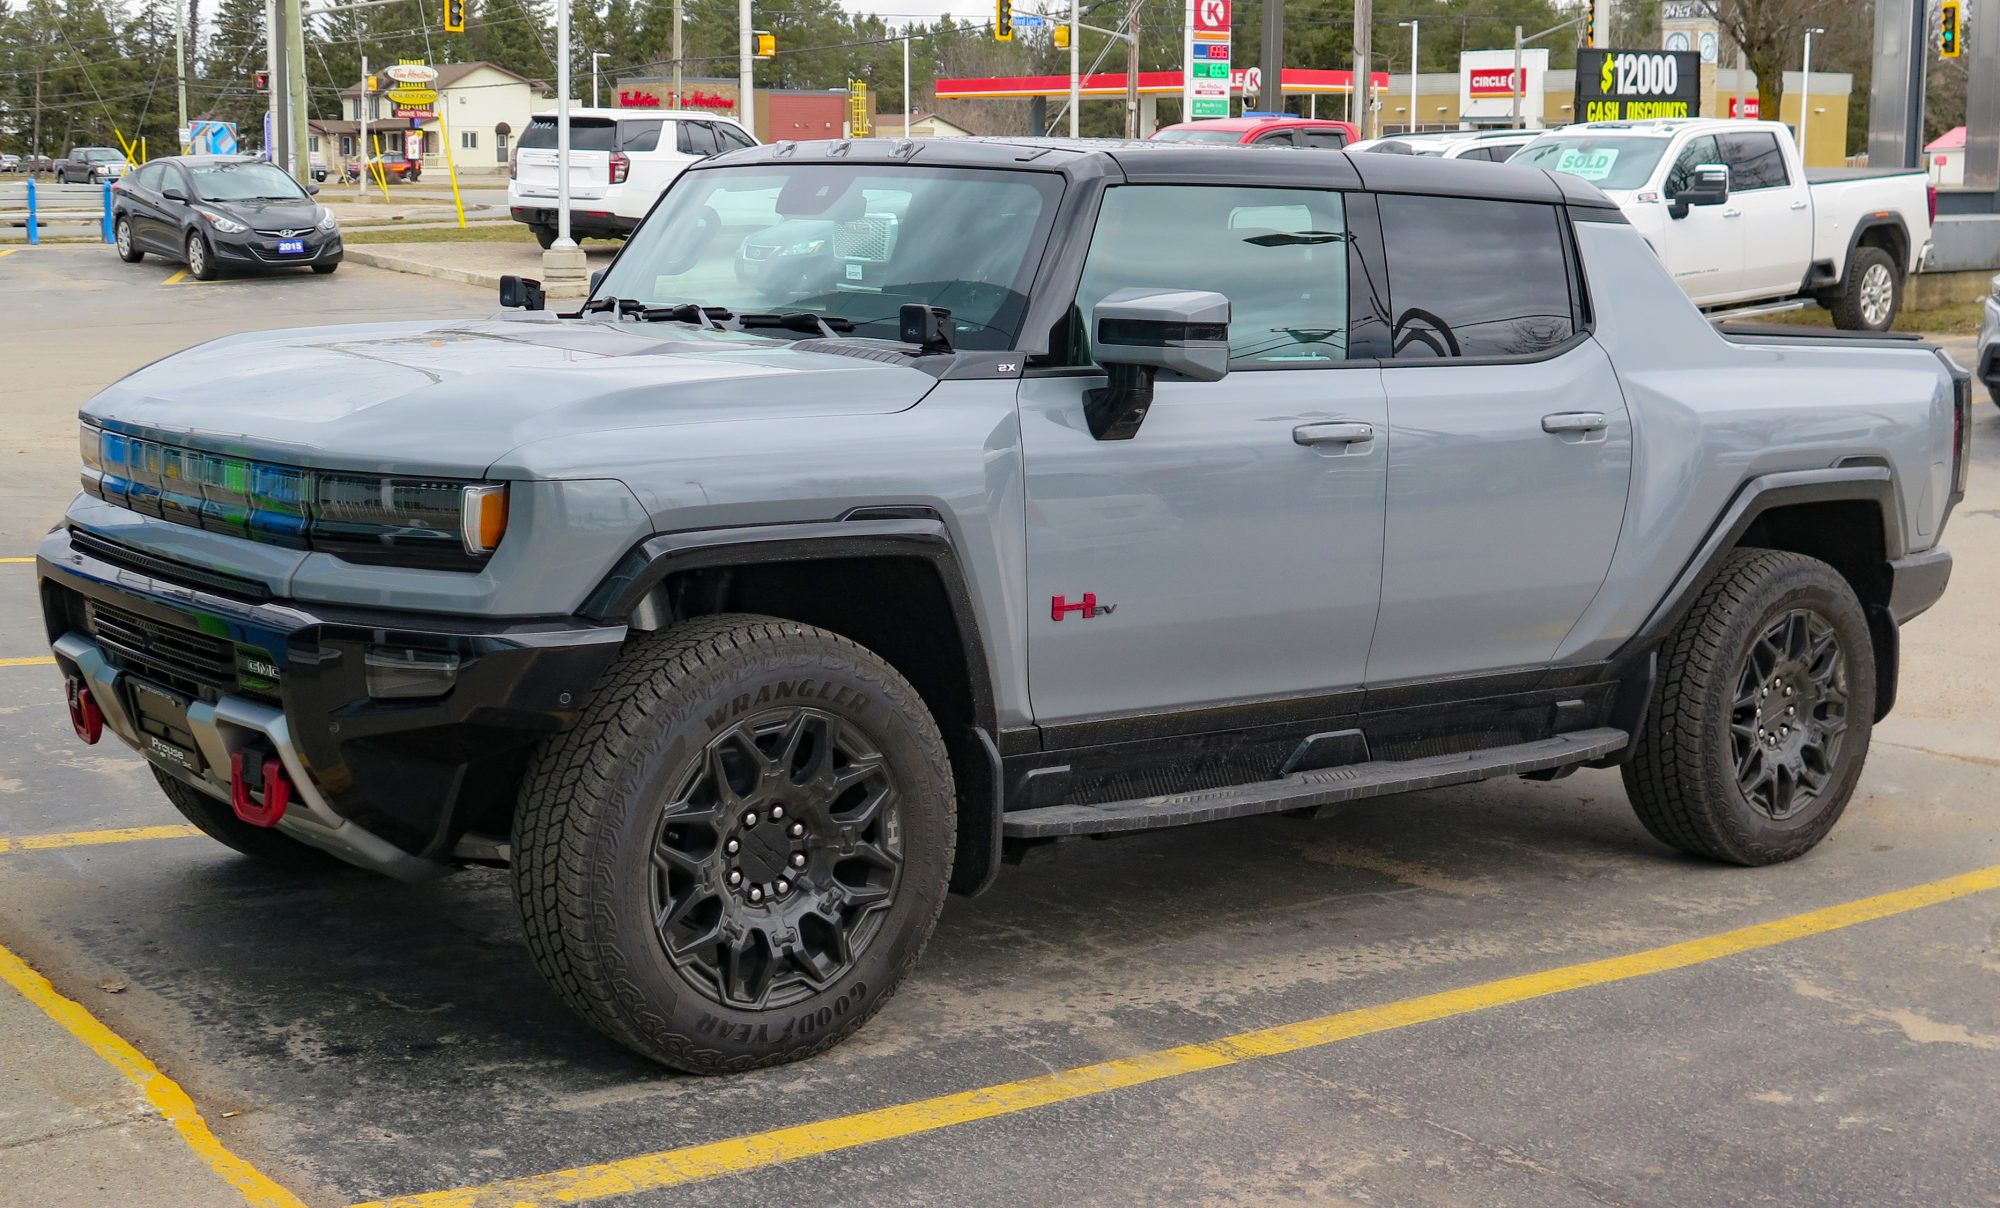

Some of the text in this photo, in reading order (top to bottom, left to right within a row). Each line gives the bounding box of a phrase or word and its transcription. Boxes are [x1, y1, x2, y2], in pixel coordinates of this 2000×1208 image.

[1207, 2, 1222, 26] K
[1472, 76, 1507, 87] CIRCLE
[1600, 53, 1678, 95] $12000
[1587, 101, 1688, 122] CASH DISCOUNTS
[1562, 155, 1609, 169] SOLD
[280, 242, 302, 251] 2015
[997, 363, 1016, 372] 2X
[248, 660, 281, 680] GMC
[704, 678, 872, 732] WRANGLER
[151, 736, 184, 760] Prouse
